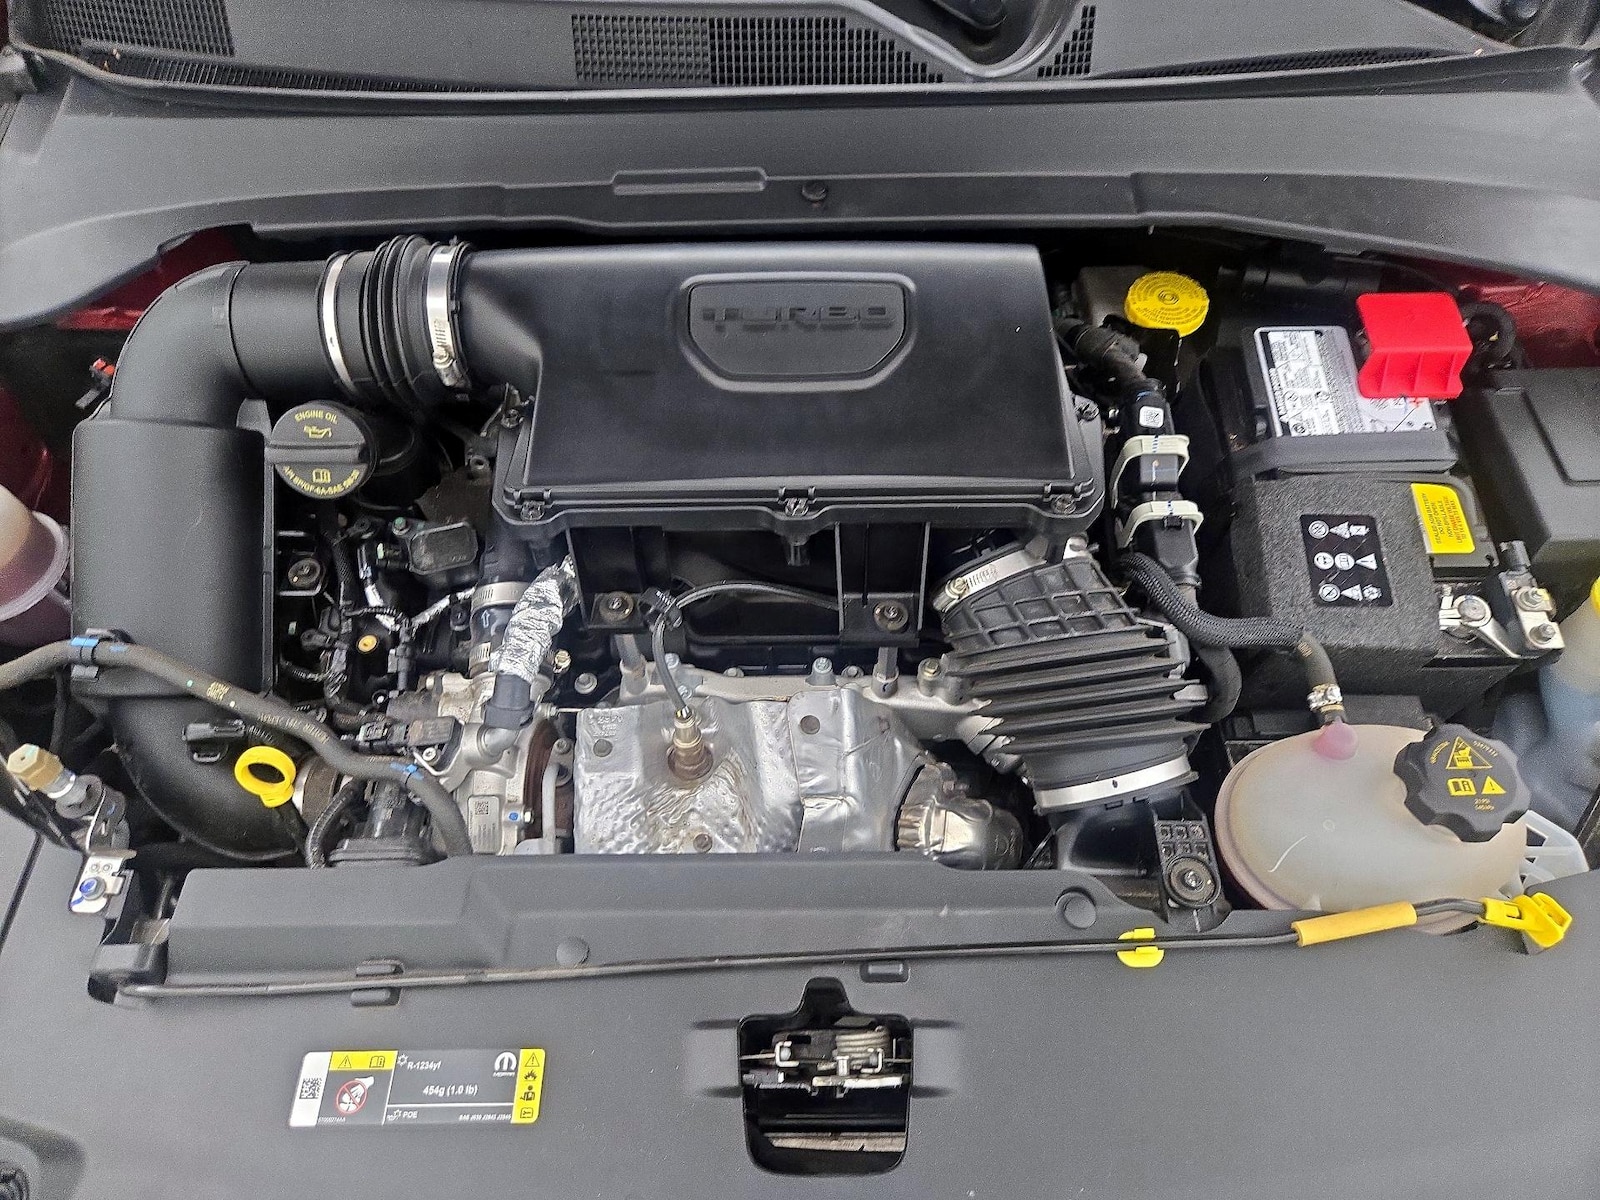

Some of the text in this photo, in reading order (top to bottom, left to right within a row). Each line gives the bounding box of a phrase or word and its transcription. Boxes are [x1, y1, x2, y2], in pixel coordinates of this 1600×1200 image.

[294, 410, 338, 424] ENGINE OIL
[407, 1060, 442, 1071] R-1234yf
[422, 1084, 478, 1097] 454g (1.0 lb)
[402, 1110, 418, 1119] POE
